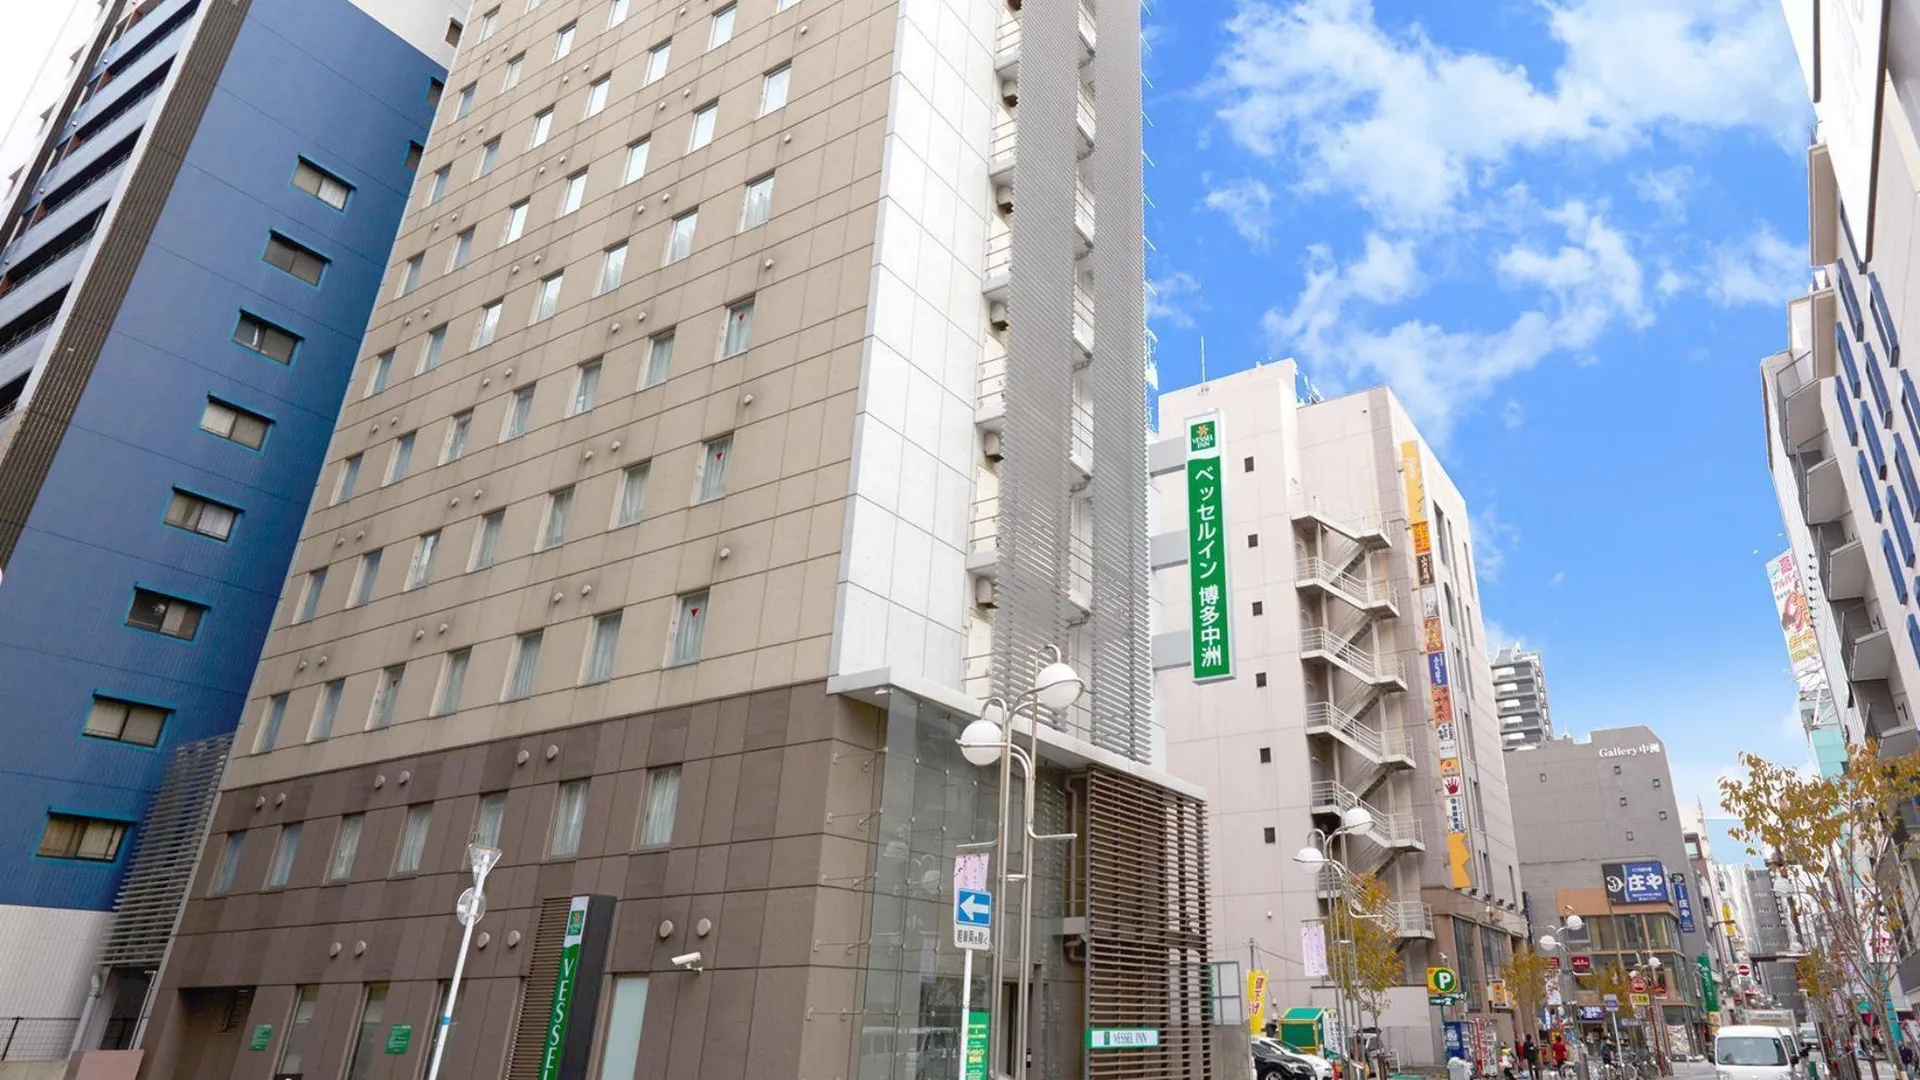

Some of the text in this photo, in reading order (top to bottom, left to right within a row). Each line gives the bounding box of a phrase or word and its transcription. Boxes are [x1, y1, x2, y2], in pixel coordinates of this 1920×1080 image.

[1194, 466, 1222, 667] ベッセルイン 博多中洲
[1628, 873, 1663, 892] 庄や
[1438, 972, 1451, 989] P
[1113, 1032, 1147, 1044] VESSEL INN
